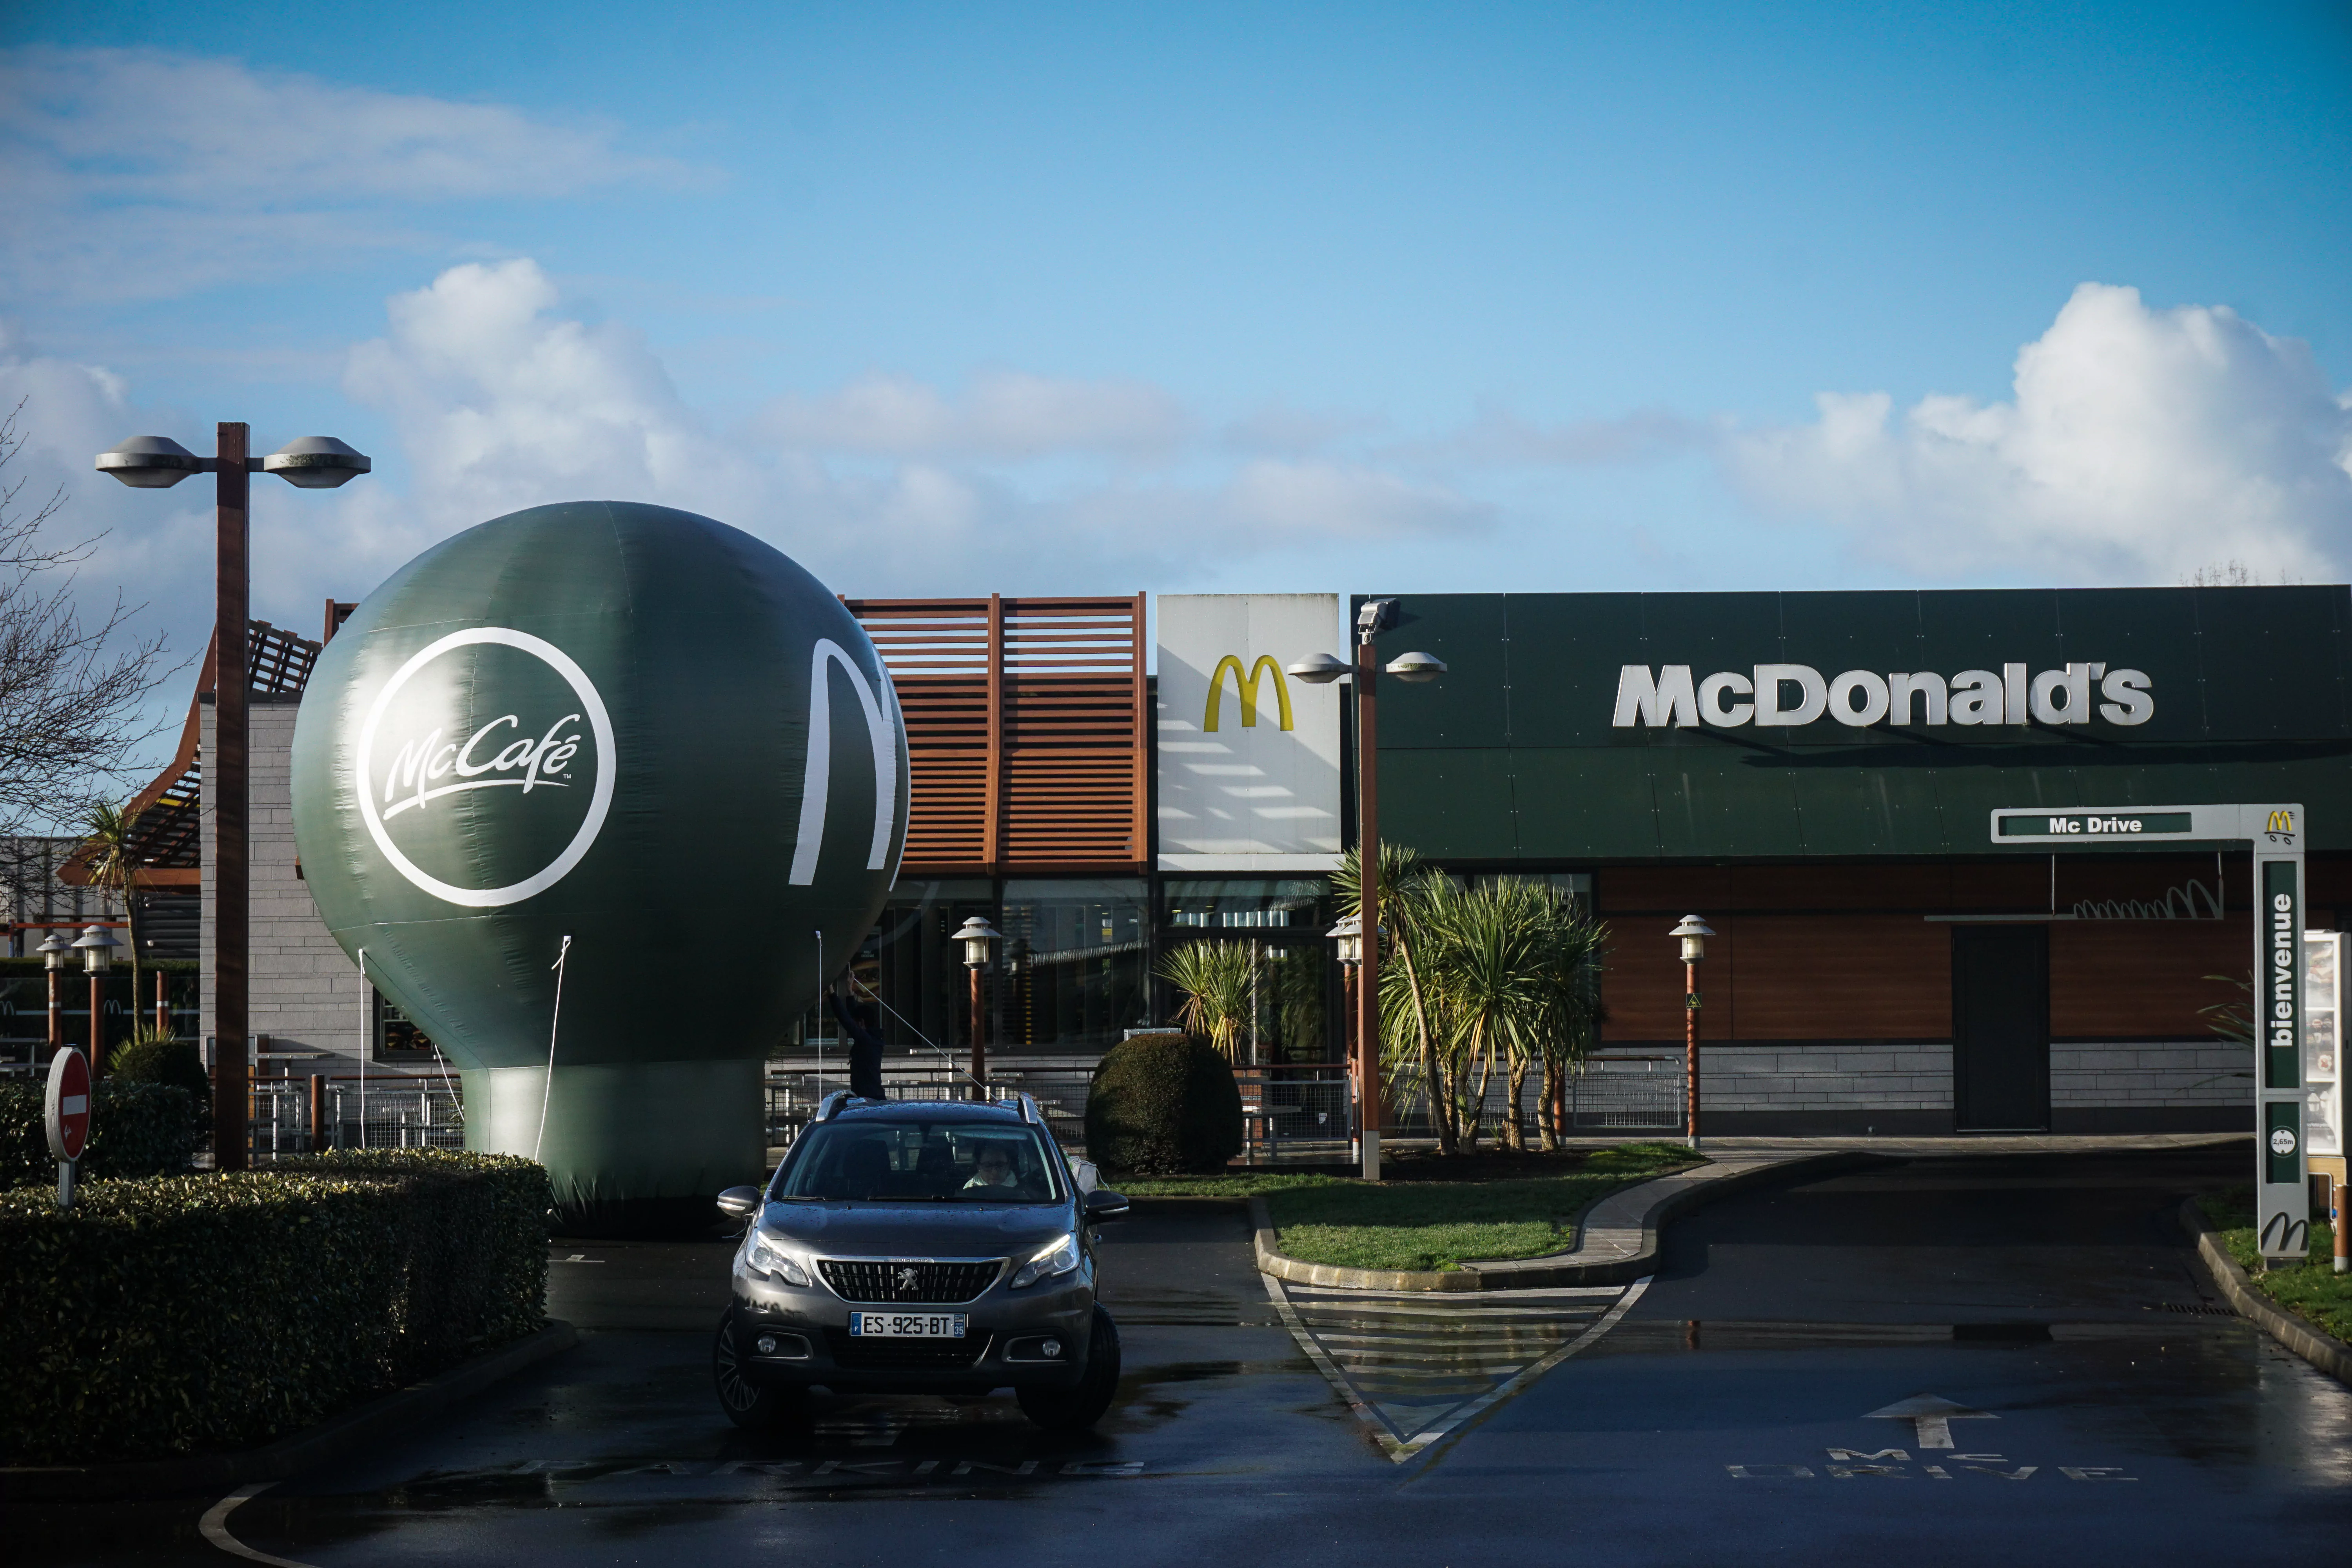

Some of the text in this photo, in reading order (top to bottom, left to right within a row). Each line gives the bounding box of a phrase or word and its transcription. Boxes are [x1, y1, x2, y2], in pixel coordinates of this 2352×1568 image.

[1613, 662, 2154, 727] McDonald's
[385, 714, 581, 809] McCafé
[2049, 817, 2142, 834] Mc Drive
[2270, 893, 2292, 1047] bienvenue
[864, 1316, 949, 1334] ES-925-BT
[955, 1326, 964, 1335] 35
[1724, 1464, 2139, 1481] DRIVE
